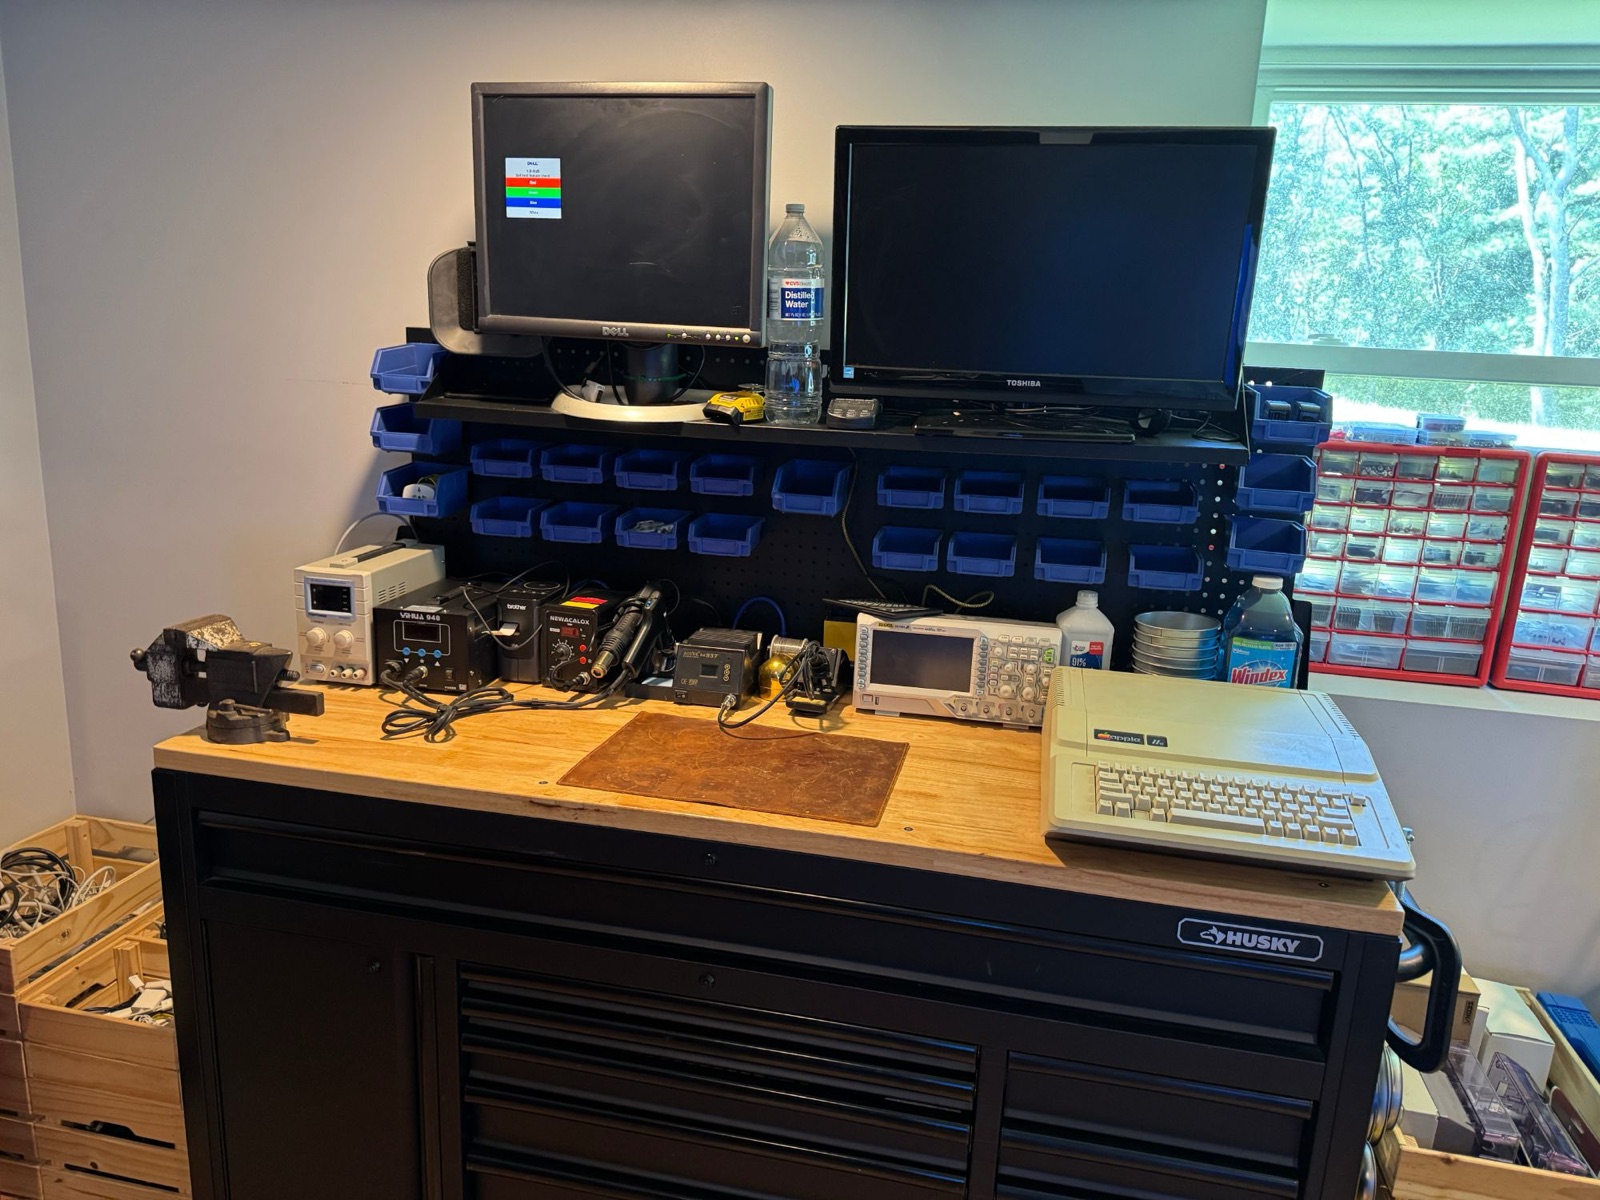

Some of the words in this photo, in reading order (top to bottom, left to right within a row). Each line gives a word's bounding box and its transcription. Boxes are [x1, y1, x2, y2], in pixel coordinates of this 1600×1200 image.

[785, 291, 815, 299] Distilled
[785, 300, 809, 308] Water
[602, 326, 629, 337] DELL
[1006, 379, 1041, 387] TOSHIBA
[506, 603, 527, 611] brother
[549, 615, 590, 625] NEWACALOX
[1072, 657, 1087, 667] 91%
[1231, 666, 1288, 684] Windex
[1110, 734, 1141, 742] apple
[1226, 930, 1300, 953] HUSKY
